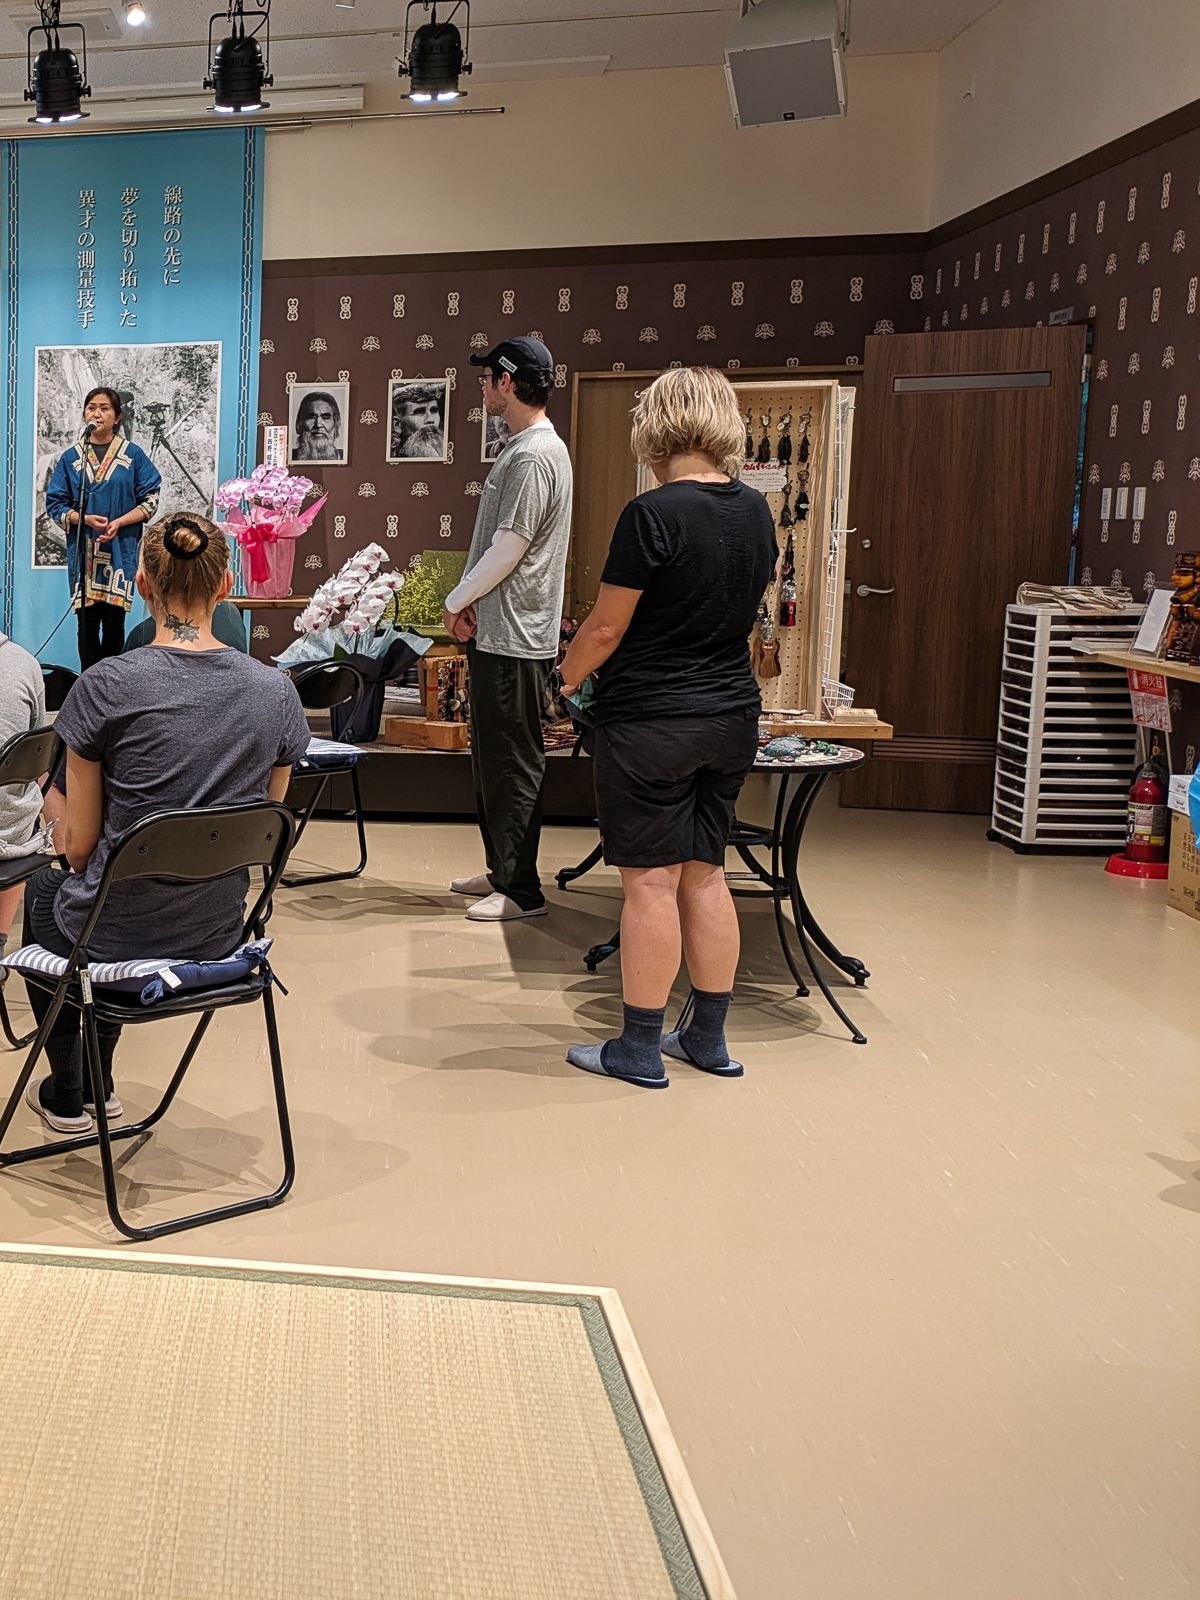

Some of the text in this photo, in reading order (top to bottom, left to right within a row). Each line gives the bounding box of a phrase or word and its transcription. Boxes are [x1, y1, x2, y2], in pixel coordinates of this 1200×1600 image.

[76, 189, 97, 330] 異才の測量技手
[119, 187, 140, 328] 夢を切り拓いた
[163, 185, 184, 286] 線路の先に
